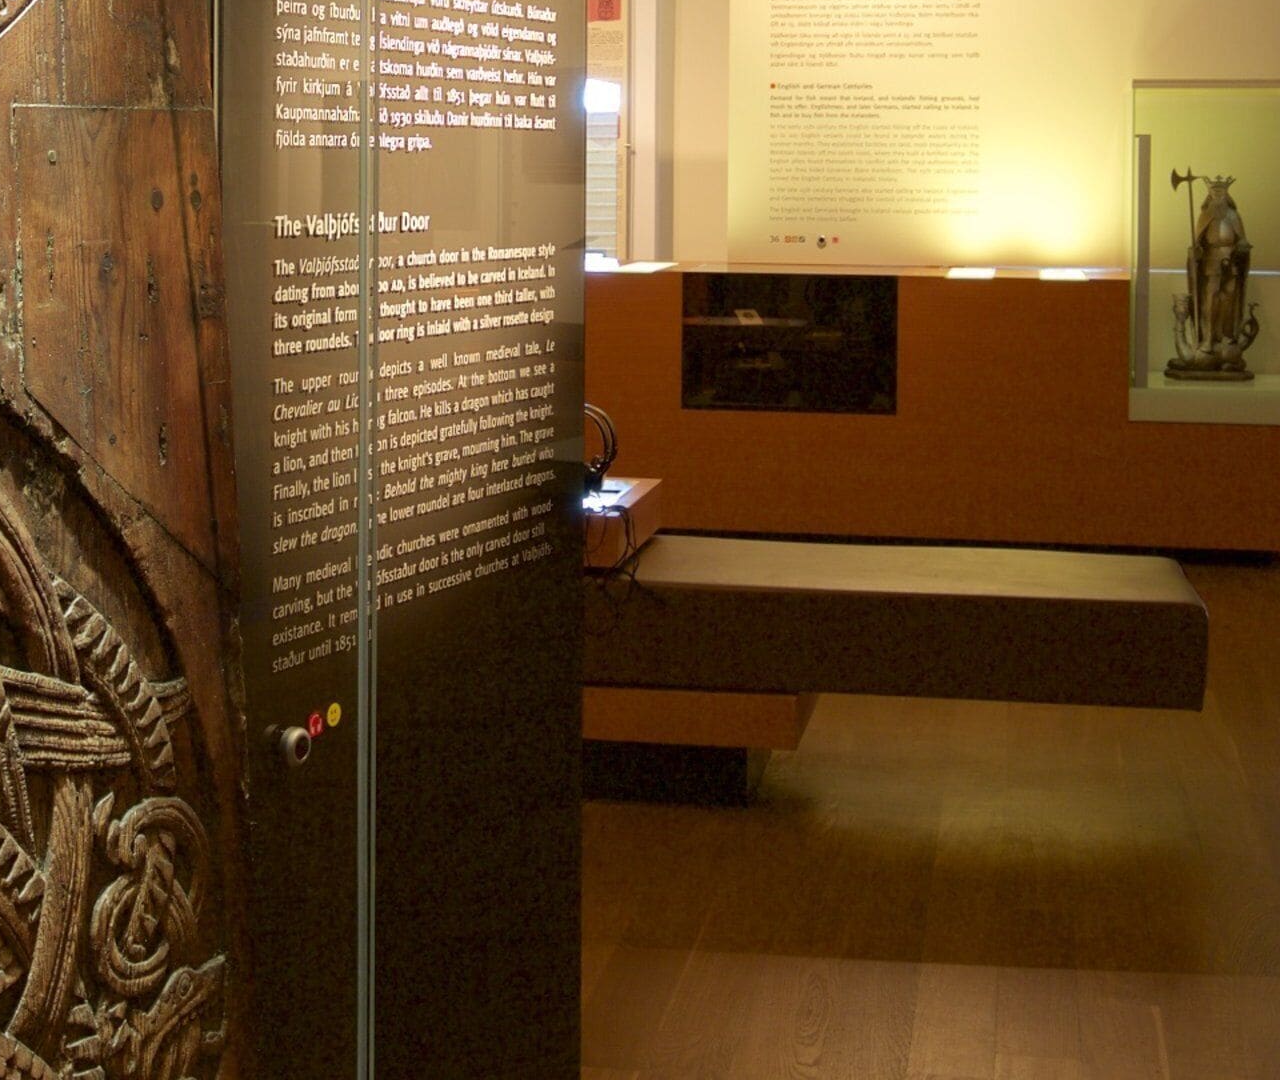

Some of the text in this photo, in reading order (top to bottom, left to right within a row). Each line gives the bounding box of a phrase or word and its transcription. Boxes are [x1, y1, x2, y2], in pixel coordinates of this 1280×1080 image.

[276, 23, 348, 45] sýna jafnframt
[276, 50, 336, 69] staðahurðin
[276, 76, 340, 98] fyrir kirkjum
[276, 129, 306, 149] fjölda
[309, 134, 347, 146] annarra
[274, 214, 302, 236] The
[402, 212, 430, 231] Door
[274, 259, 295, 275] The
[407, 250, 436, 265] church
[439, 249, 459, 263] door
[275, 268, 506, 303] dating from believed carved
[274, 289, 513, 329] its original form thought have been third
[274, 339, 302, 355] three
[306, 332, 352, 351] roundels.
[397, 324, 415, 341] ring
[427, 319, 451, 335] inlaid
[453, 317, 471, 332] with
[480, 314, 502, 329] silver
[274, 377, 294, 393] The
[302, 375, 332, 393] upper
[379, 360, 412, 379] depicts
[430, 353, 448, 369] well
[454, 352, 481, 366] known
[486, 343, 521, 360] medieval
[274, 369, 516, 421] Chevalier three episodes. bottom
[274, 382, 555, 448] knight with his falcon. kills dragon which caught
[283, 404, 554, 472] lion, and then depicted gratefully following knight.
[274, 480, 310, 500] Finally,
[313, 476, 330, 492] the
[333, 472, 351, 487] lion
[381, 460, 396, 475] the
[435, 449, 460, 466] grave,
[462, 439, 500, 456] mourning
[534, 428, 554, 443] grave
[288, 449, 537, 523] inscribed in Behold mighty king here buried
[273, 537, 298, 554] slew
[301, 530, 318, 547] the
[321, 522, 358, 542] dragon.
[390, 505, 415, 521] lower
[417, 493, 450, 514] roundel
[468, 487, 484, 501] four
[486, 475, 523, 496] interlaced
[273, 575, 302, 592] Many
[306, 557, 351, 583] medieval
[397, 534, 435, 555] churches
[439, 529, 459, 542] were
[512, 506, 528, 521] with
[273, 529, 530, 619] carving, but the door only carved door
[272, 558, 509, 646] existance. use successive churches
[272, 635, 356, 672] staður until 1851
